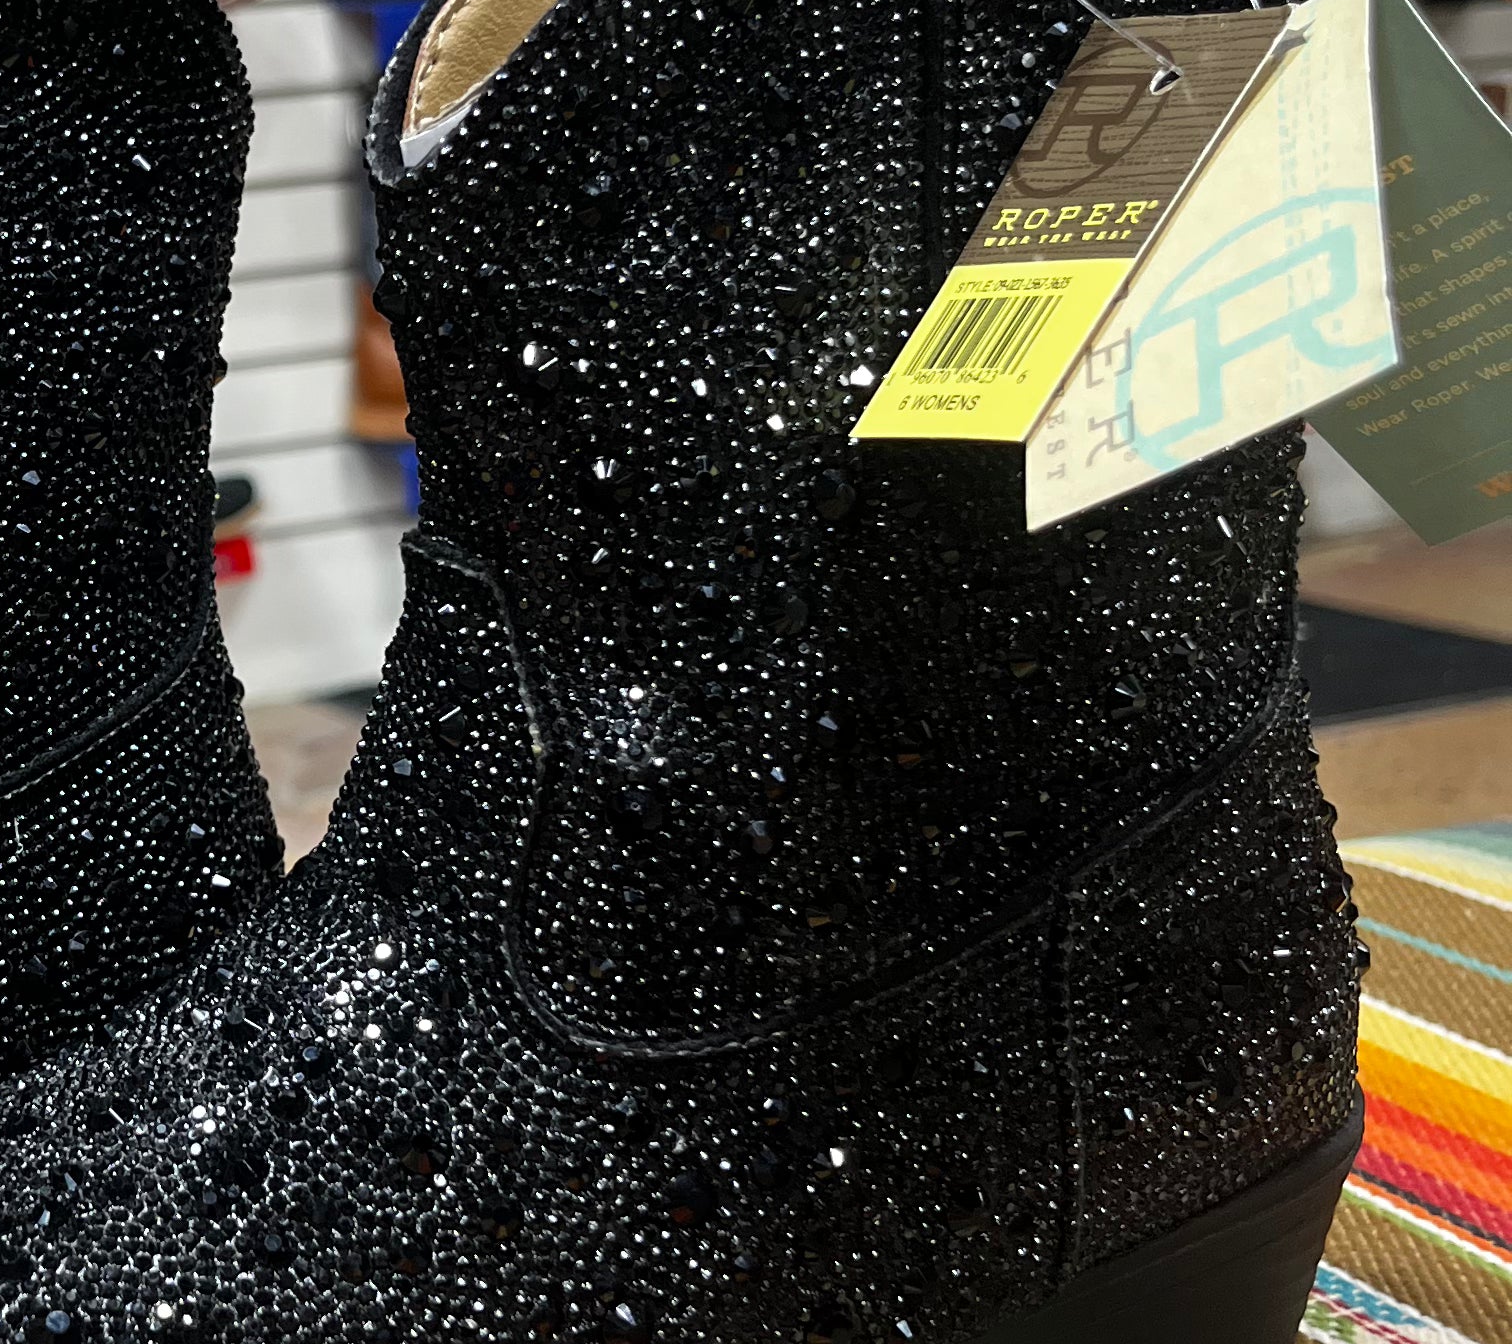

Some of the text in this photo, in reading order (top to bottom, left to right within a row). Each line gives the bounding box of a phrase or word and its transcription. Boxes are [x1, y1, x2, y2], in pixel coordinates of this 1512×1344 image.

[991, 200, 1150, 232] ROPER
[1412, 223, 1428, 236] a
[1449, 217, 1505, 253] spirit
[1438, 255, 1509, 296] shapes
[1436, 302, 1487, 334] sewn
[1485, 286, 1512, 307] int
[1345, 322, 1512, 411] soul and everythin
[898, 394, 982, 412] 6 WOMENS
[1355, 408, 1409, 438] Wear
